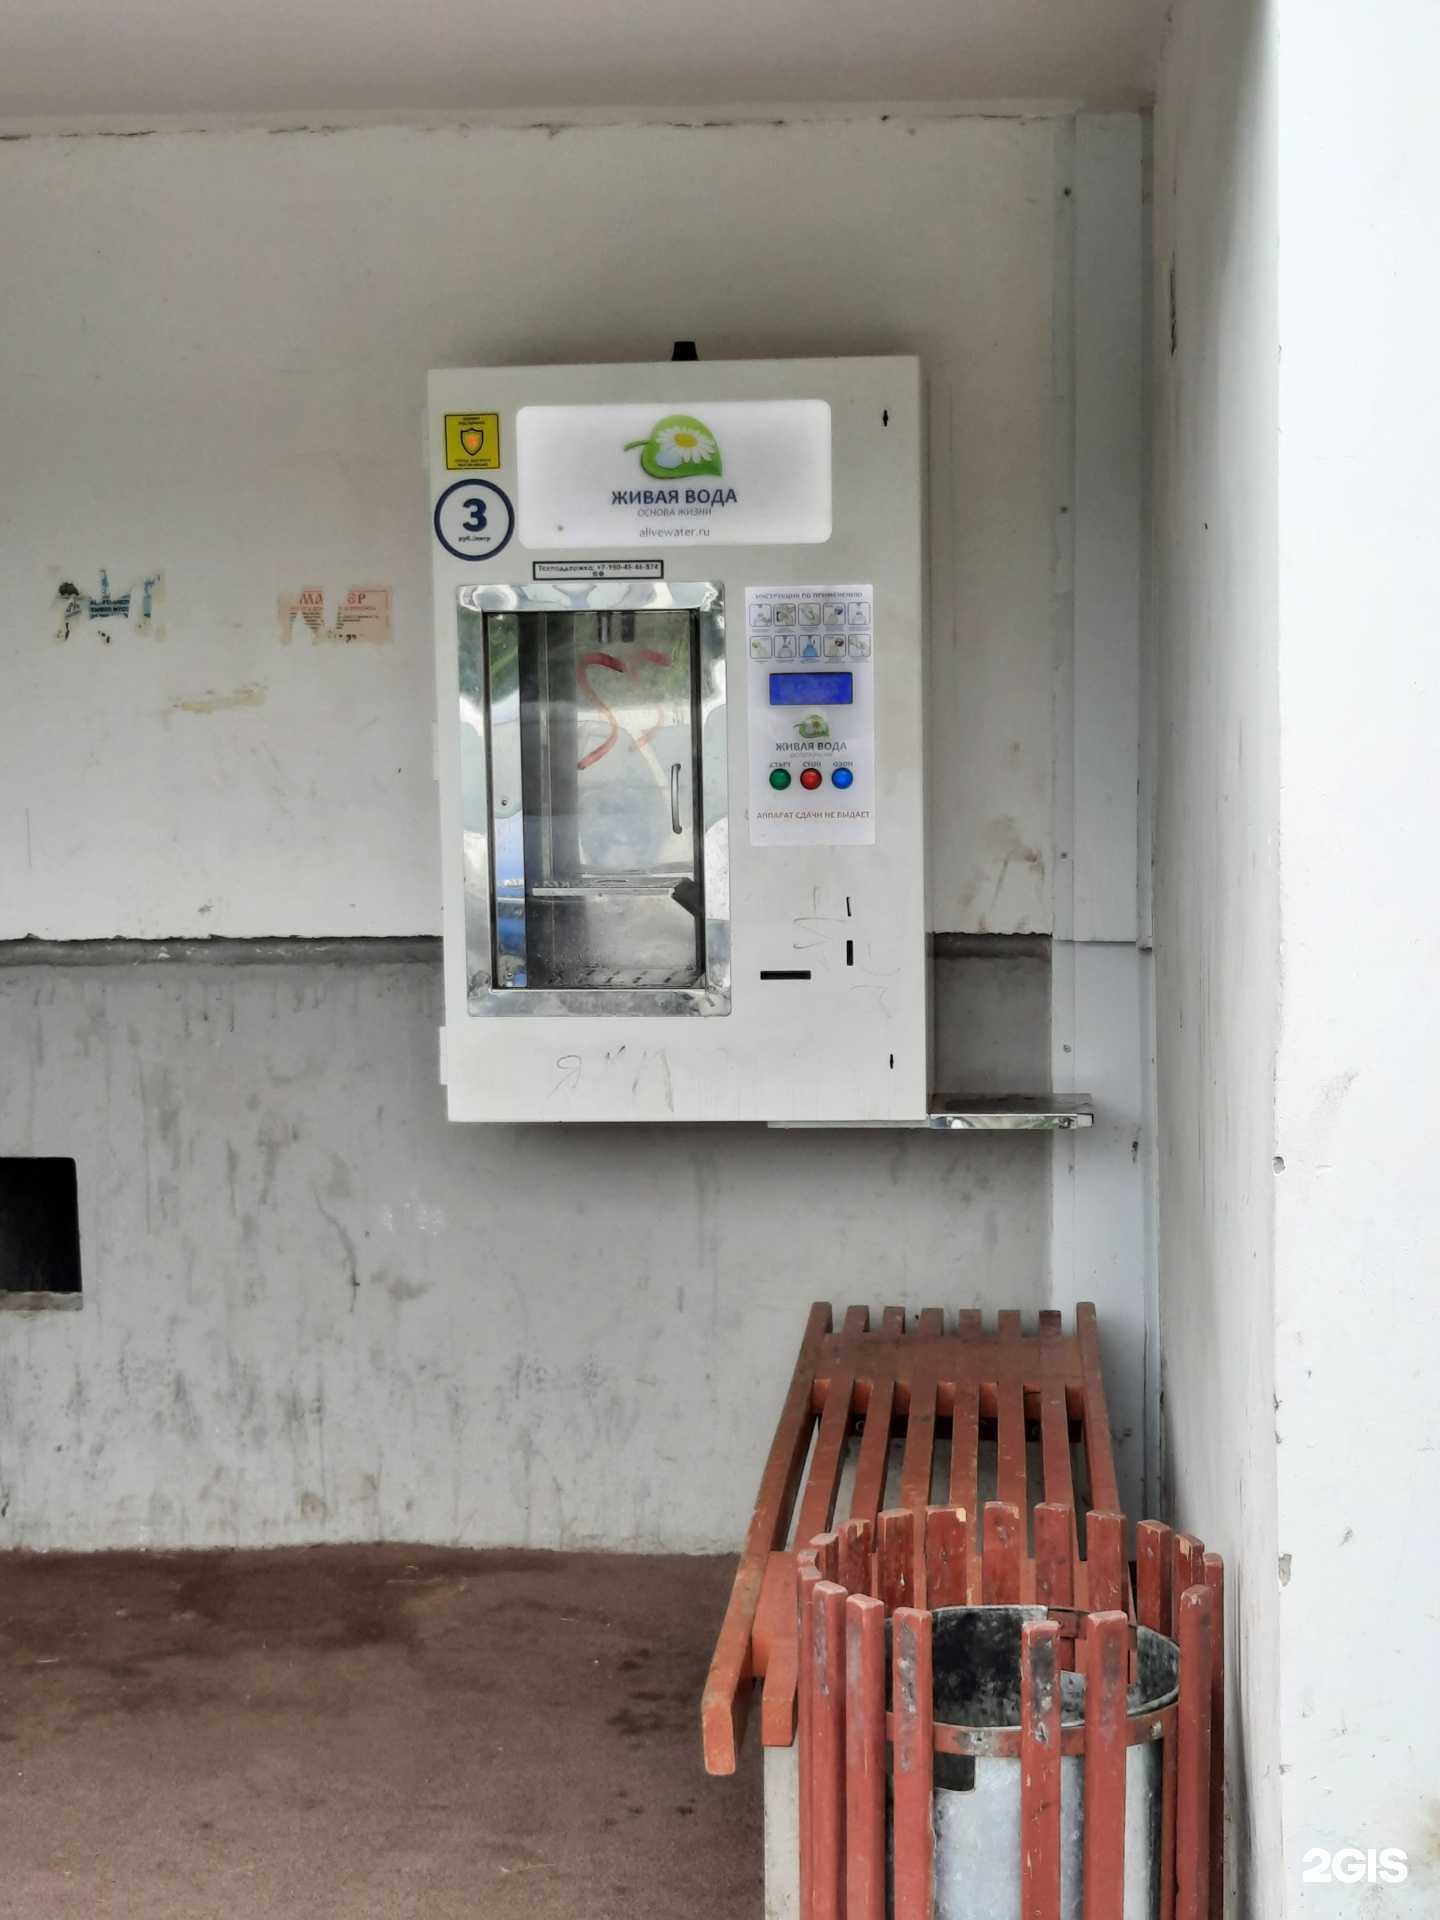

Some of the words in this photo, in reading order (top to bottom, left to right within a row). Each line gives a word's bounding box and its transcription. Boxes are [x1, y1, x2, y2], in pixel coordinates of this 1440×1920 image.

[611, 490, 679, 505] ЖИВАЯ
[685, 488, 738, 507] ВОДА
[462, 498, 487, 532] 3
[637, 509, 676, 518] ОСНОВА
[677, 507, 712, 517] ЖИЗНИ
[639, 526, 710, 538] alivewater.ru
[775, 742, 815, 752] ЖИВАЯ
[817, 741, 848, 753] ВОДА
[795, 811, 823, 819] СДАЧИ
[837, 810, 870, 818] ВЫДАЕТ
